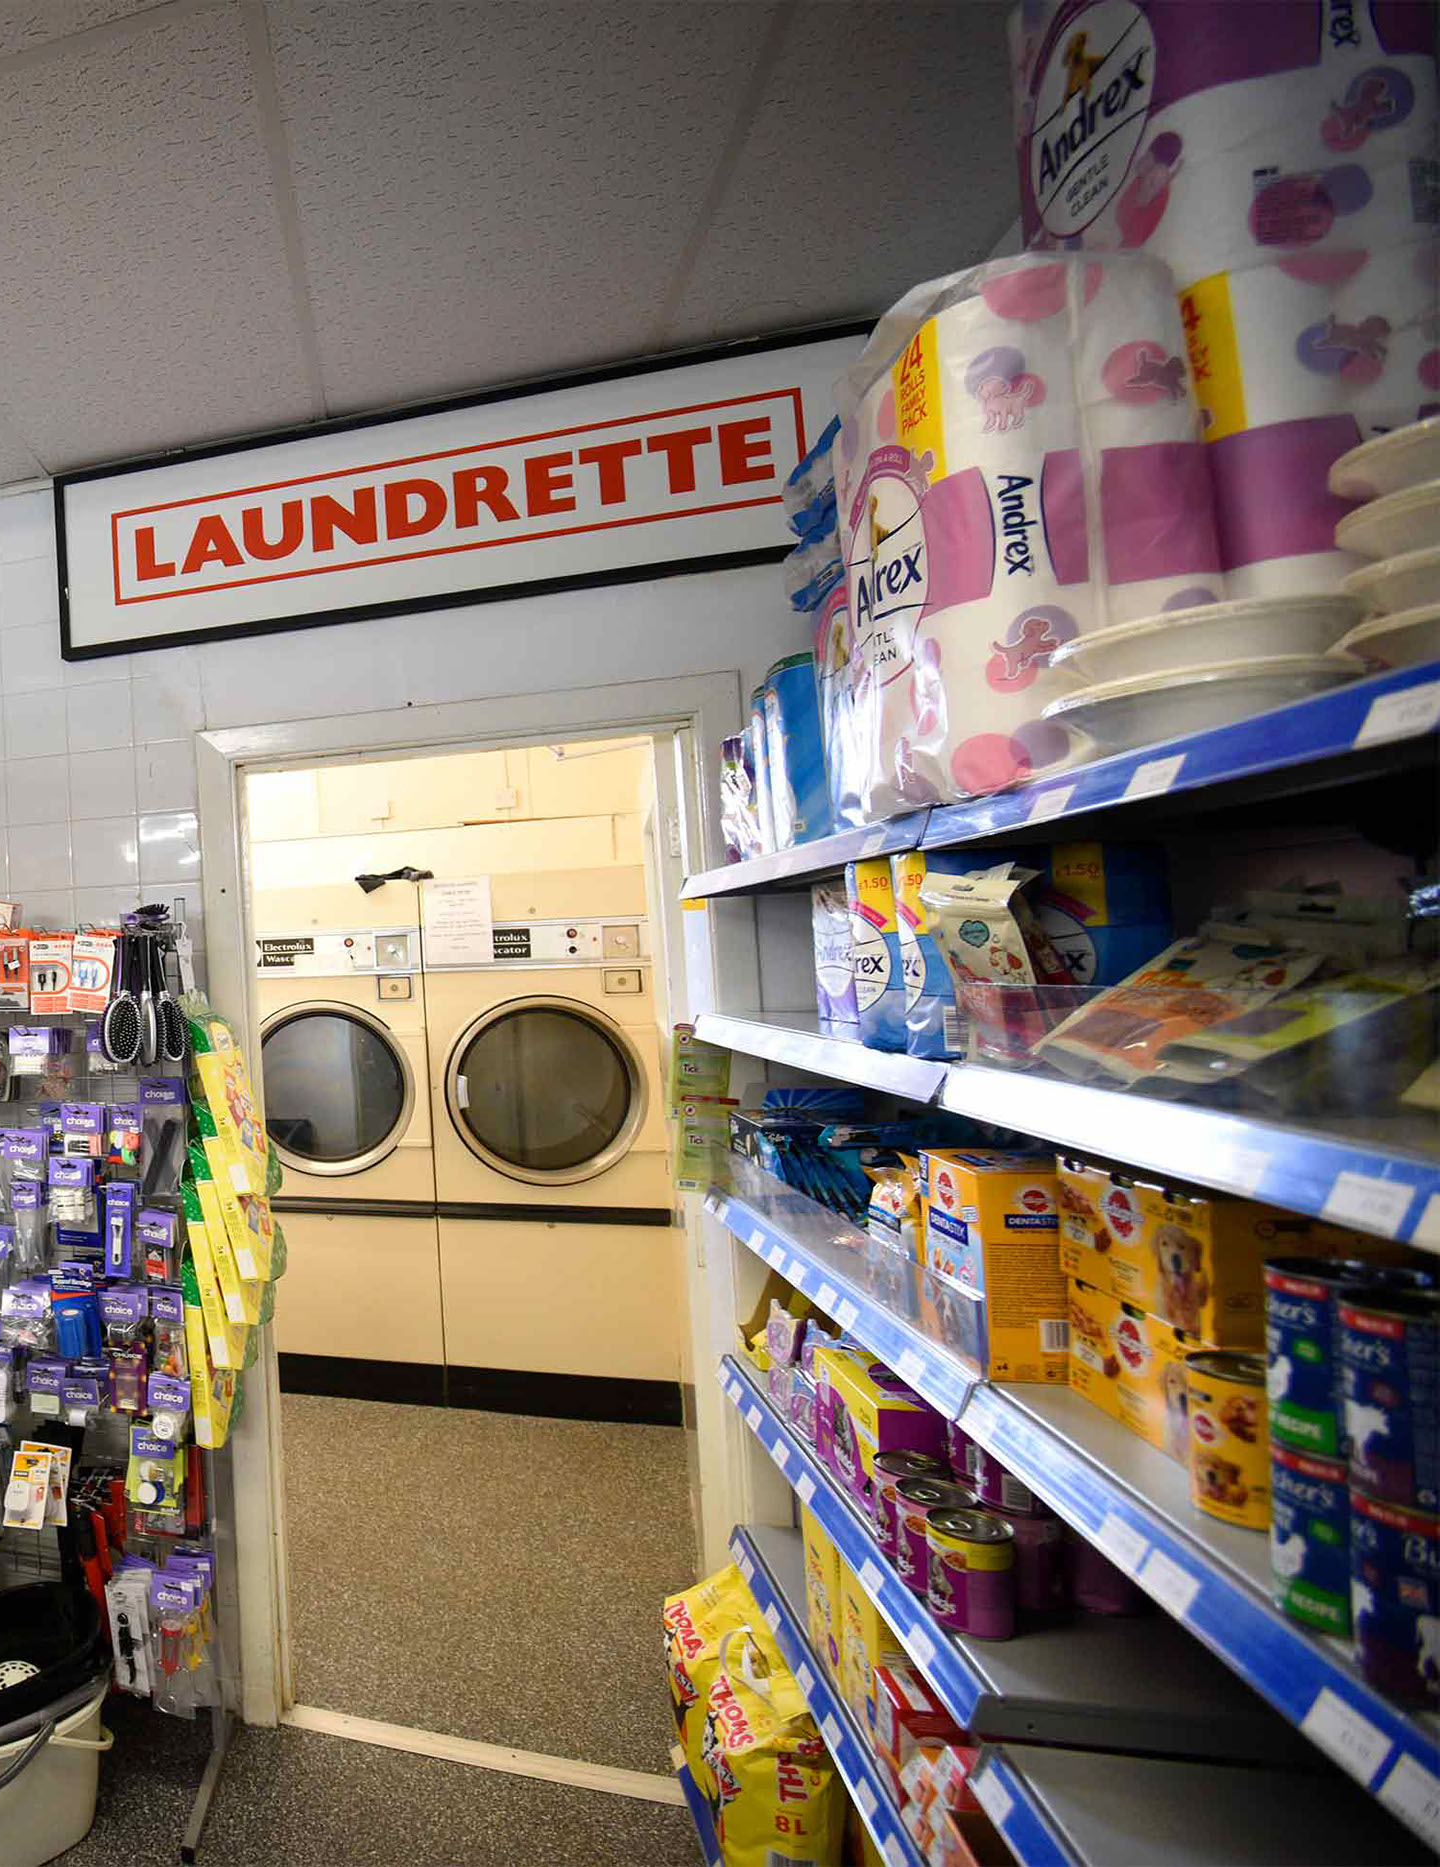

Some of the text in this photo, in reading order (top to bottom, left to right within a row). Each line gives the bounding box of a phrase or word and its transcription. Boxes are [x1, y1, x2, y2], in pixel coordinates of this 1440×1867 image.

[1331, 0, 1359, 48] rex
[1039, 46, 1150, 195] Andrex
[1066, 152, 1111, 200] GENTLE
[1070, 176, 1110, 217] CLEAN
[901, 334, 924, 384] 24
[901, 370, 924, 401] ROLLS
[903, 401, 928, 437] PACK
[135, 416, 777, 582] LAUNDRETTE
[998, 475, 1039, 576] Andrex
[264, 942, 312, 952] Electrolux
[495, 933, 529, 942] trolux
[855, 956, 885, 975] rex
[104, 1306, 133, 1316] choice
[157, 1302, 178, 1315] choice
[31, 1376, 59, 1387] choice
[66, 1391, 93, 1401] choice
[153, 1391, 184, 1403] choice
[137, 1441, 167, 1452] choice
